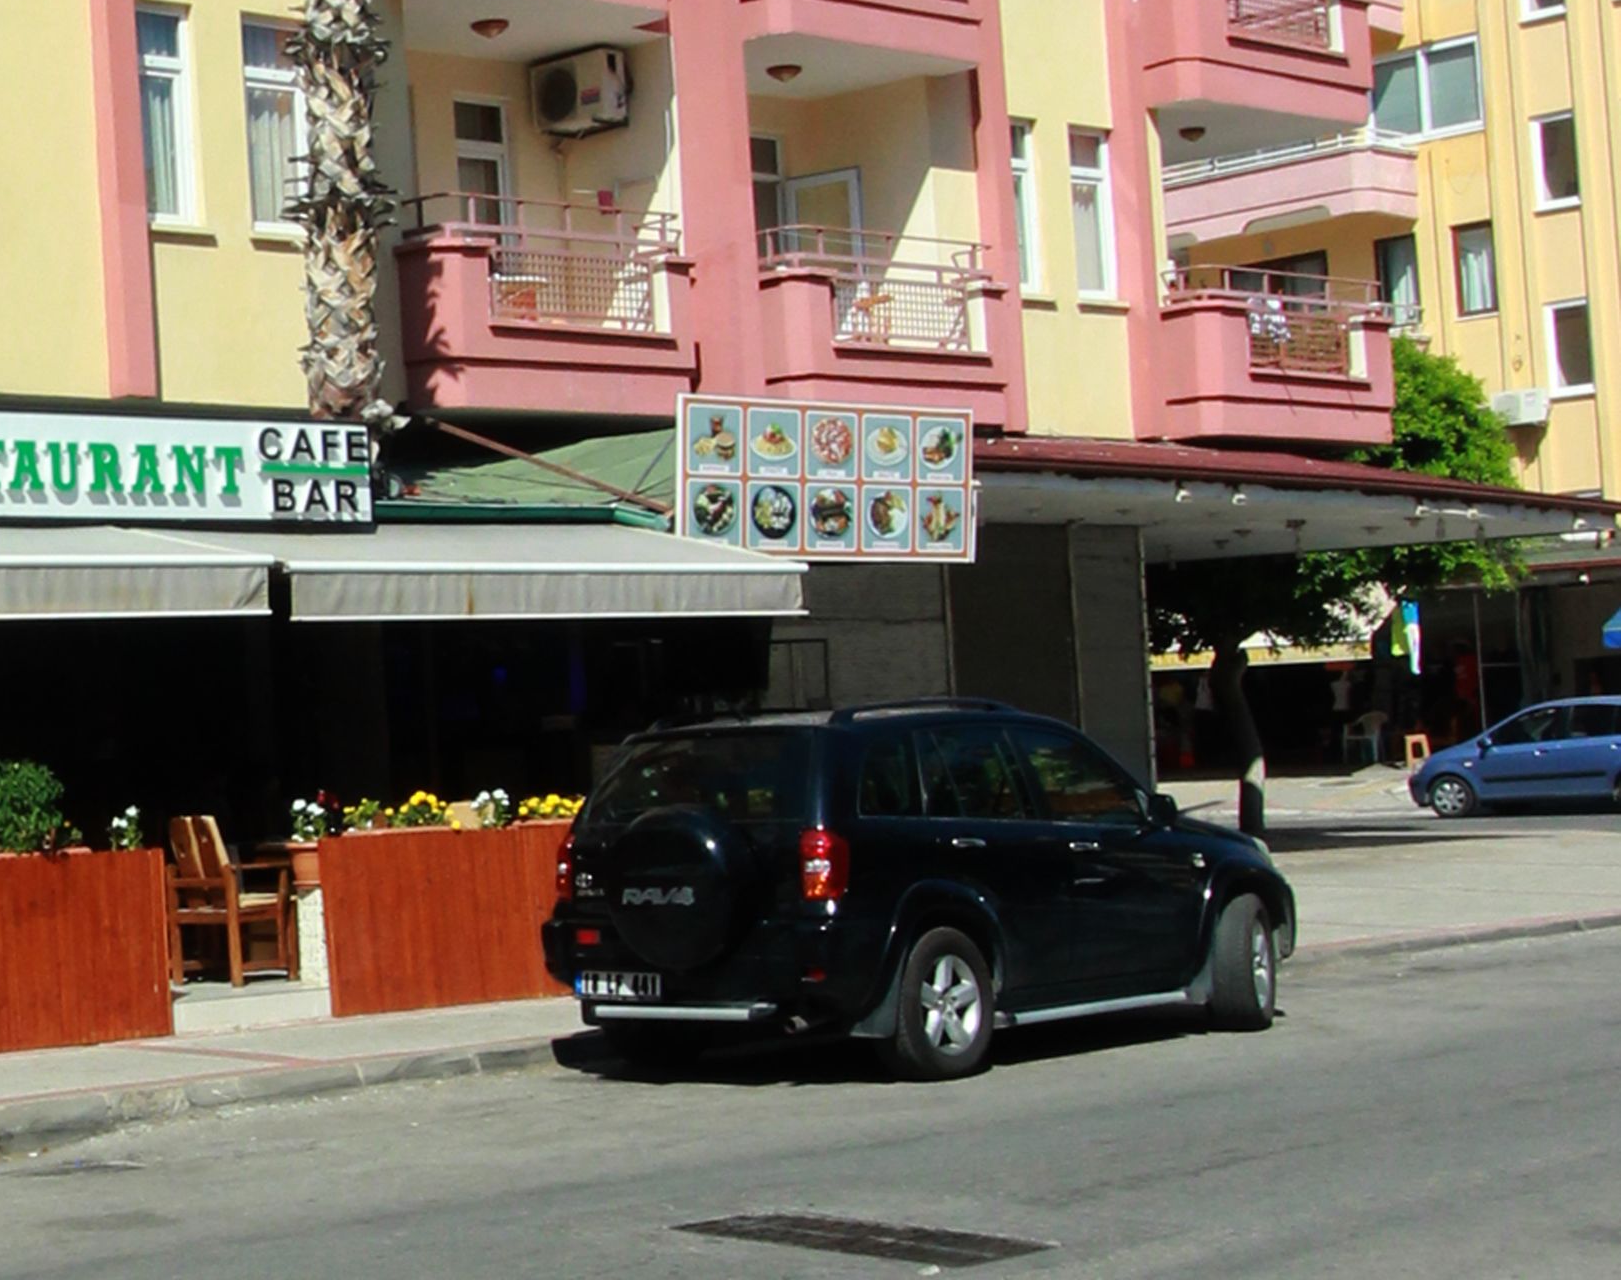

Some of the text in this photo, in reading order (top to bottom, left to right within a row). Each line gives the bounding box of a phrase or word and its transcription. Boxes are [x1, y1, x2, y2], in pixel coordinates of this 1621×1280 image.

[258, 427, 368, 462] CAFE
[271, 479, 359, 513] BAR
[622, 886, 695, 906] RAV4
